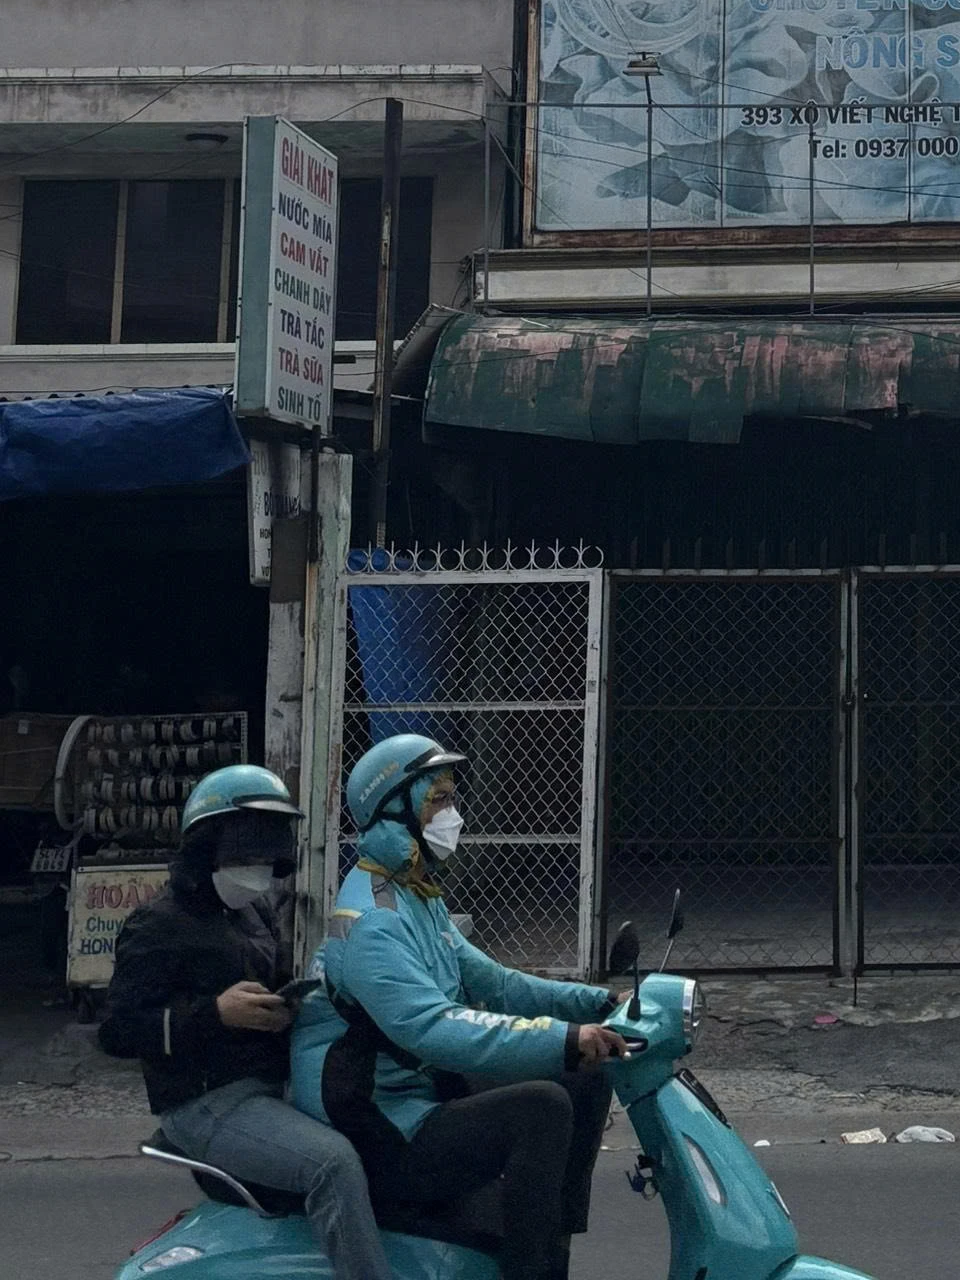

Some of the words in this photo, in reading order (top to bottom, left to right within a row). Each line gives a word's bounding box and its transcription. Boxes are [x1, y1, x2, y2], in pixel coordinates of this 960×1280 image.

[815, 26, 925, 71] NÔNG
[741, 105, 783, 126] 393
[789, 99, 820, 125] XÔ
[827, 97, 875, 125] VIẾT
[884, 99, 943, 127] NGHỆ
[809, 138, 848, 159] Tel:
[854, 138, 909, 159] 0937
[917, 137, 959, 158] 000
[282, 134, 305, 187] GIẢI
[306, 157, 334, 206] KHÁT
[278, 191, 310, 231] NƯỚC
[312, 213, 333, 245] MÍA
[280, 231, 306, 267] CAM
[274, 267, 310, 306] CHANH
[312, 286, 332, 317] DÂY
[280, 308, 302, 340] TRÀ
[278, 346, 300, 377] TRÀ
[303, 355, 324, 387] SỮA
[277, 385, 305, 417] SINH
[307, 392, 323, 422] TỐ
[86, 915, 124, 937] Chuy
[78, 938, 114, 955] HON
